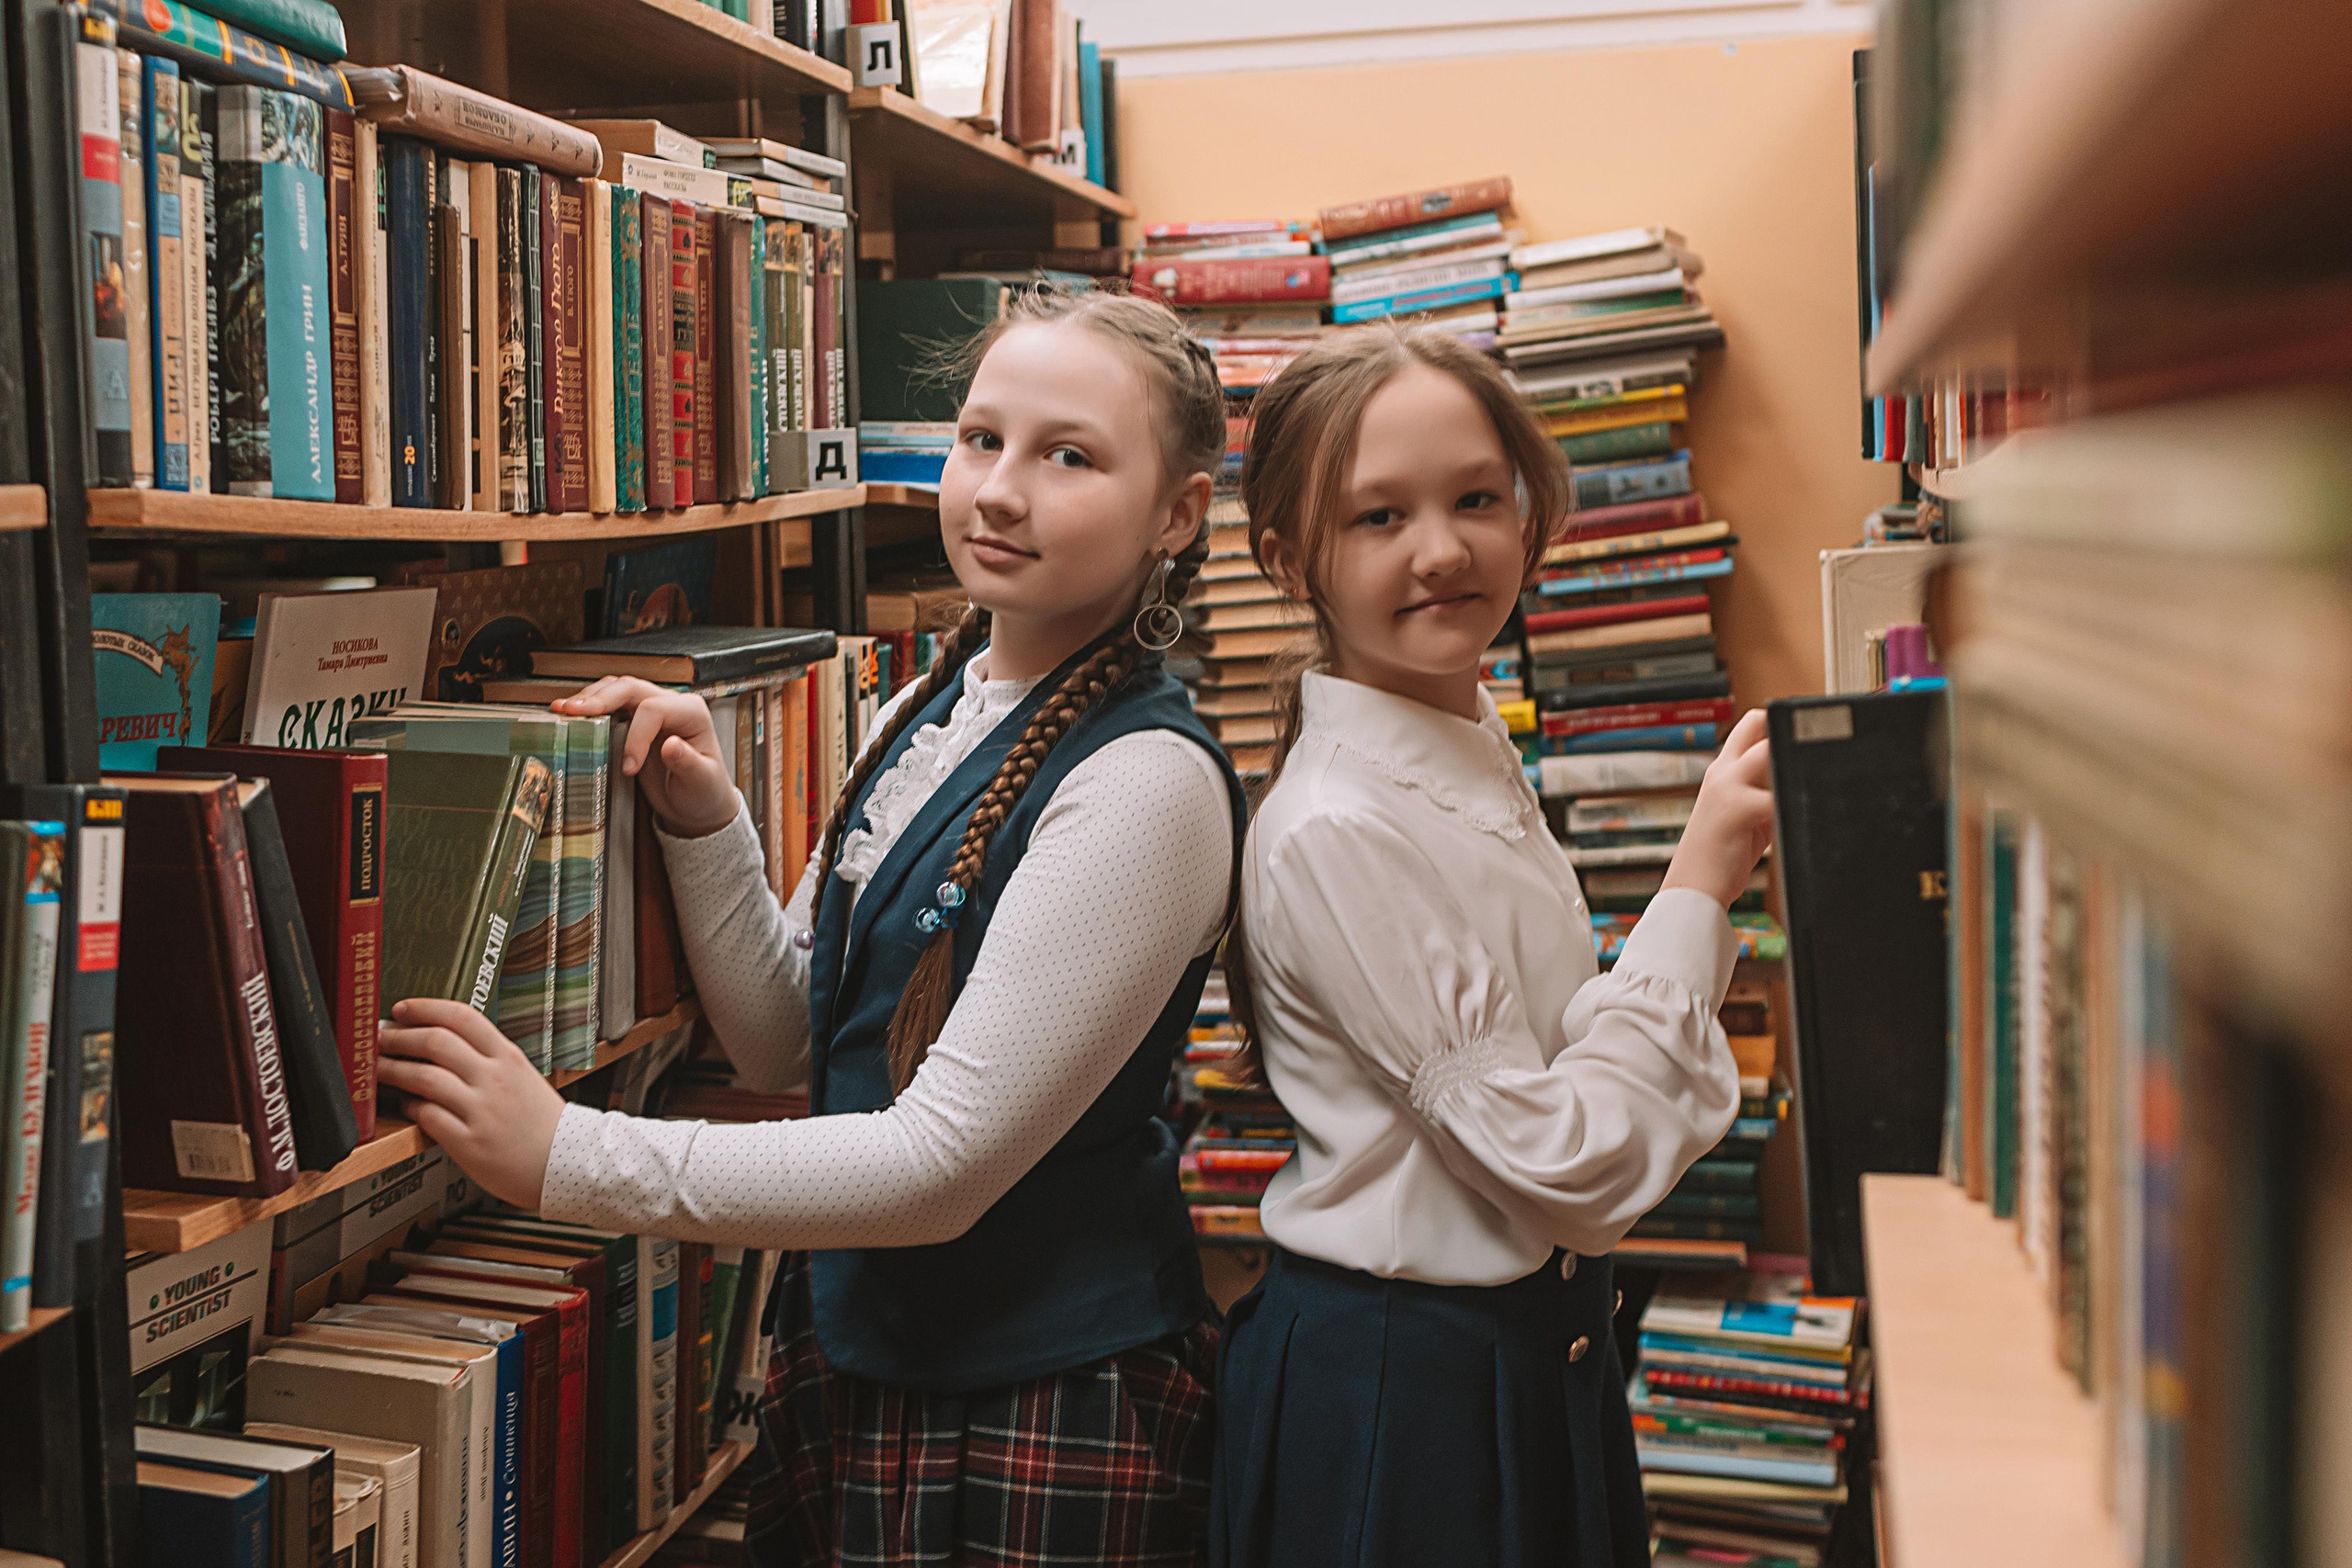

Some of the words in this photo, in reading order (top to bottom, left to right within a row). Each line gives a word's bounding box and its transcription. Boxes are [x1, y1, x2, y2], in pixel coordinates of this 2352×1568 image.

[867, 39, 893, 71] Л
[461, 100, 507, 126] ОБЛОМОВ
[663, 182, 688, 193] РАССКАЗЫ
[338, 214, 348, 256] ГРИН
[338, 258, 348, 276] А.
[301, 284, 315, 343] ГРИН
[567, 306, 574, 317] В.
[627, 312, 643, 398] ГЕТЕ
[305, 350, 322, 484] АЛЕКСАНДР
[404, 445, 416, 467] 20
[815, 441, 847, 481] Д
[332, 637, 379, 655] НОСИКОВА
[317, 658, 344, 673] Тамара
[344, 653, 389, 671] Дмитриевна
[361, 797, 373, 891] ПОДРОСТОК
[164, 1265, 220, 1306] YOUNG
